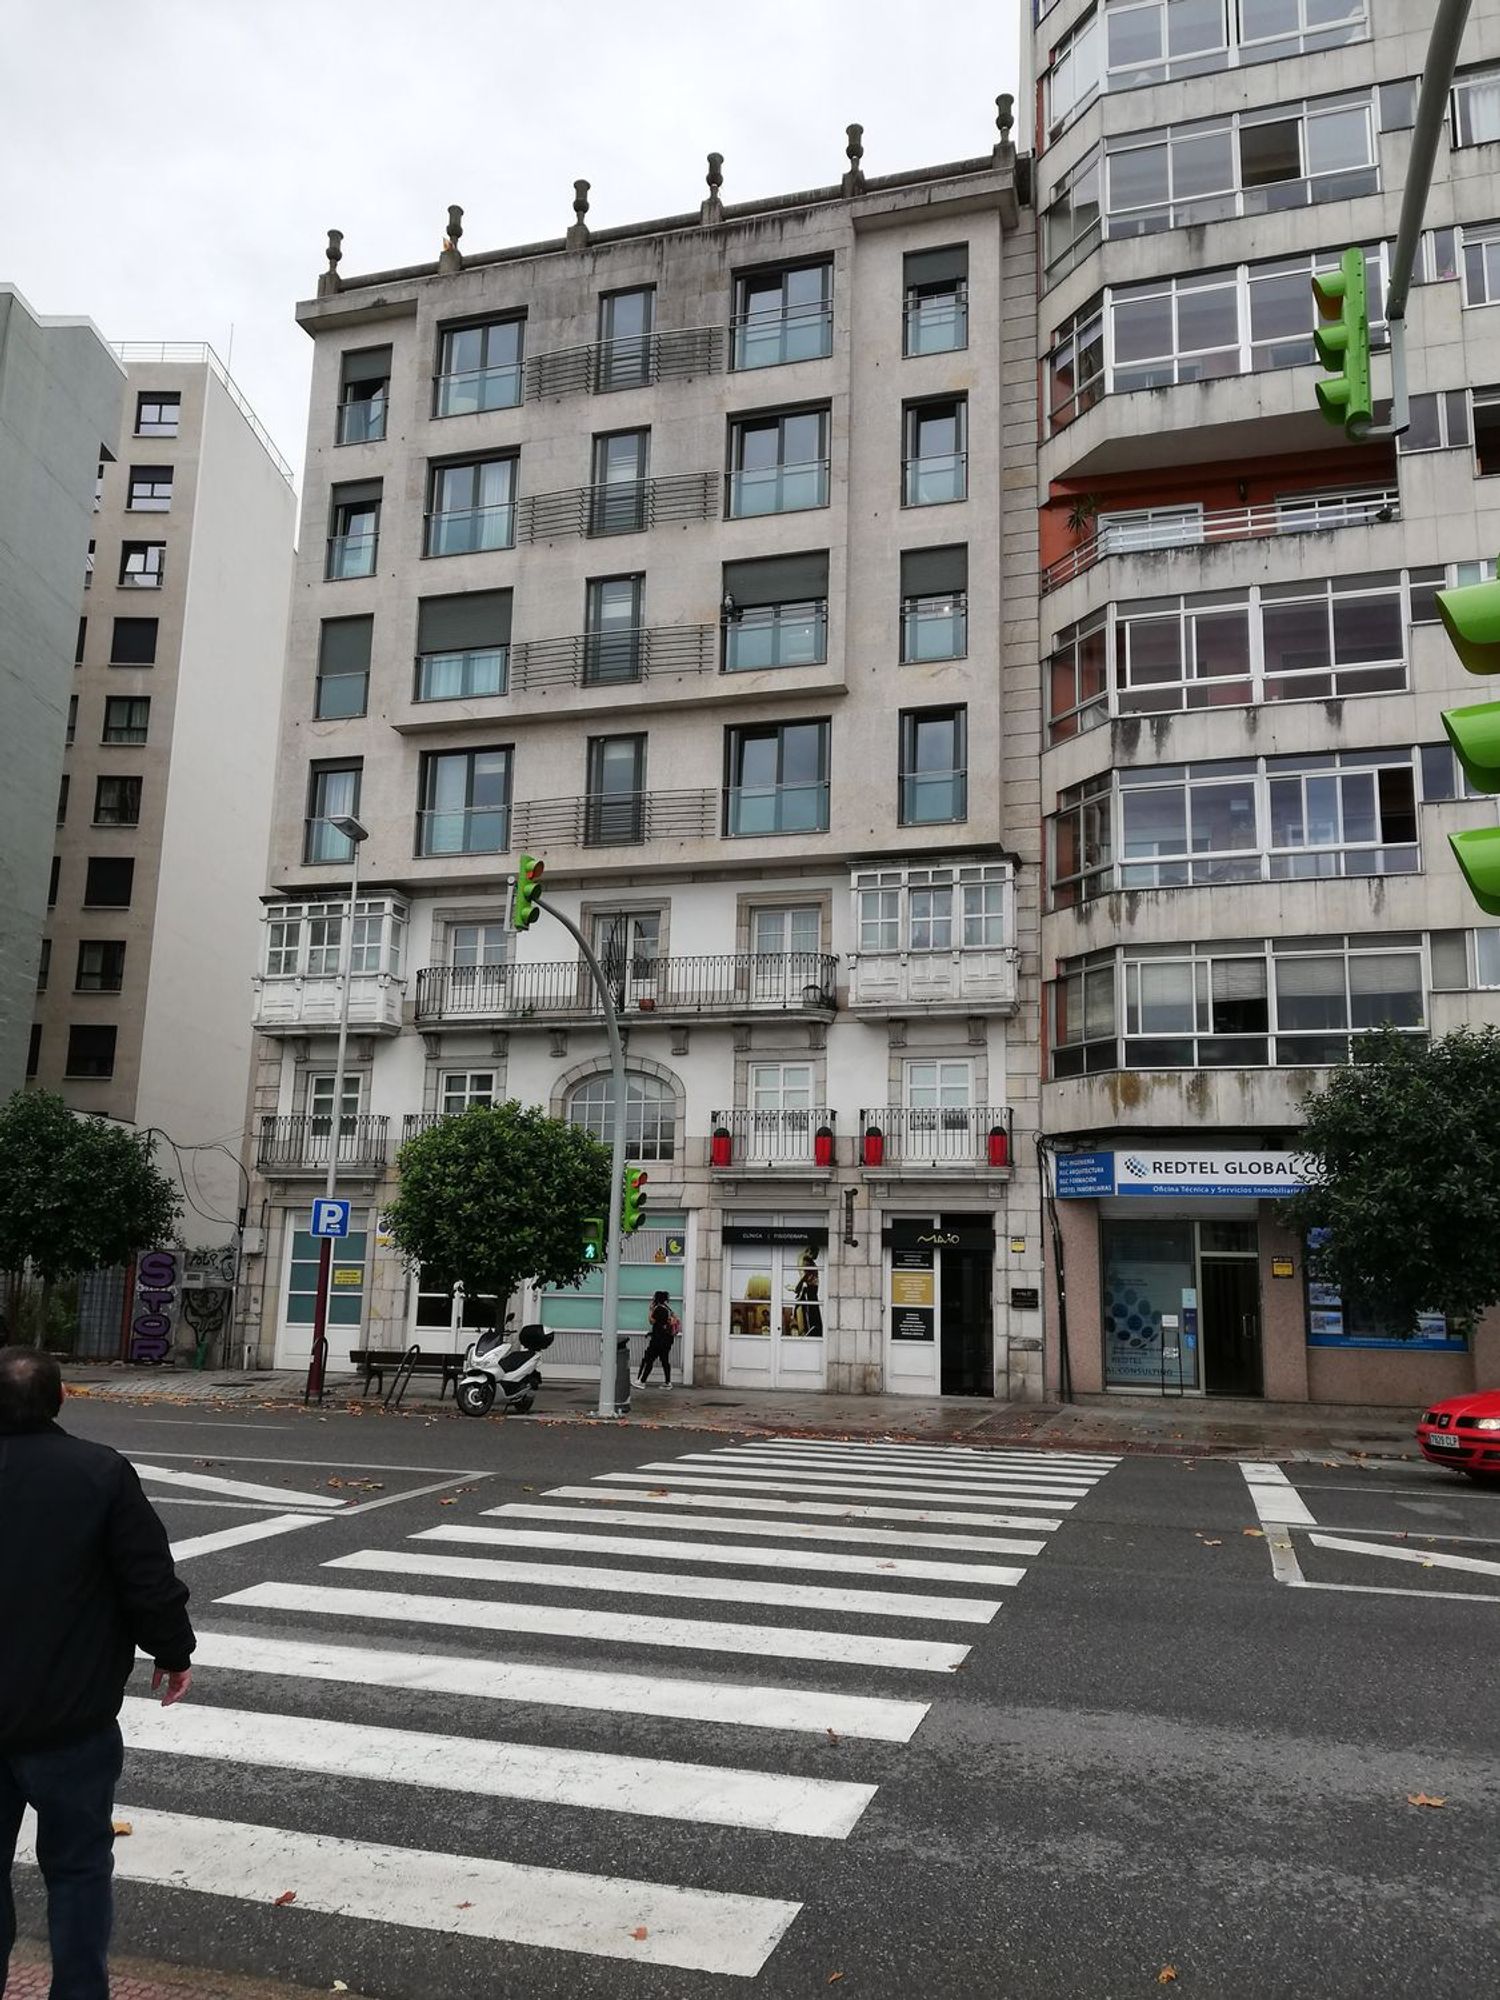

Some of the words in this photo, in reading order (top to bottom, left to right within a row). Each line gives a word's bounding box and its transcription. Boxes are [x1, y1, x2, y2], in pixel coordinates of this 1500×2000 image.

[1153, 1162, 1219, 1174] REDTEL
[1224, 1162, 1299, 1174] GLOBAL
[1153, 1185, 1179, 1193] Oficina
[1181, 1185, 1209, 1193] Técnica
[1217, 1186, 1252, 1194] Servicios
[319, 1204, 343, 1232] P
